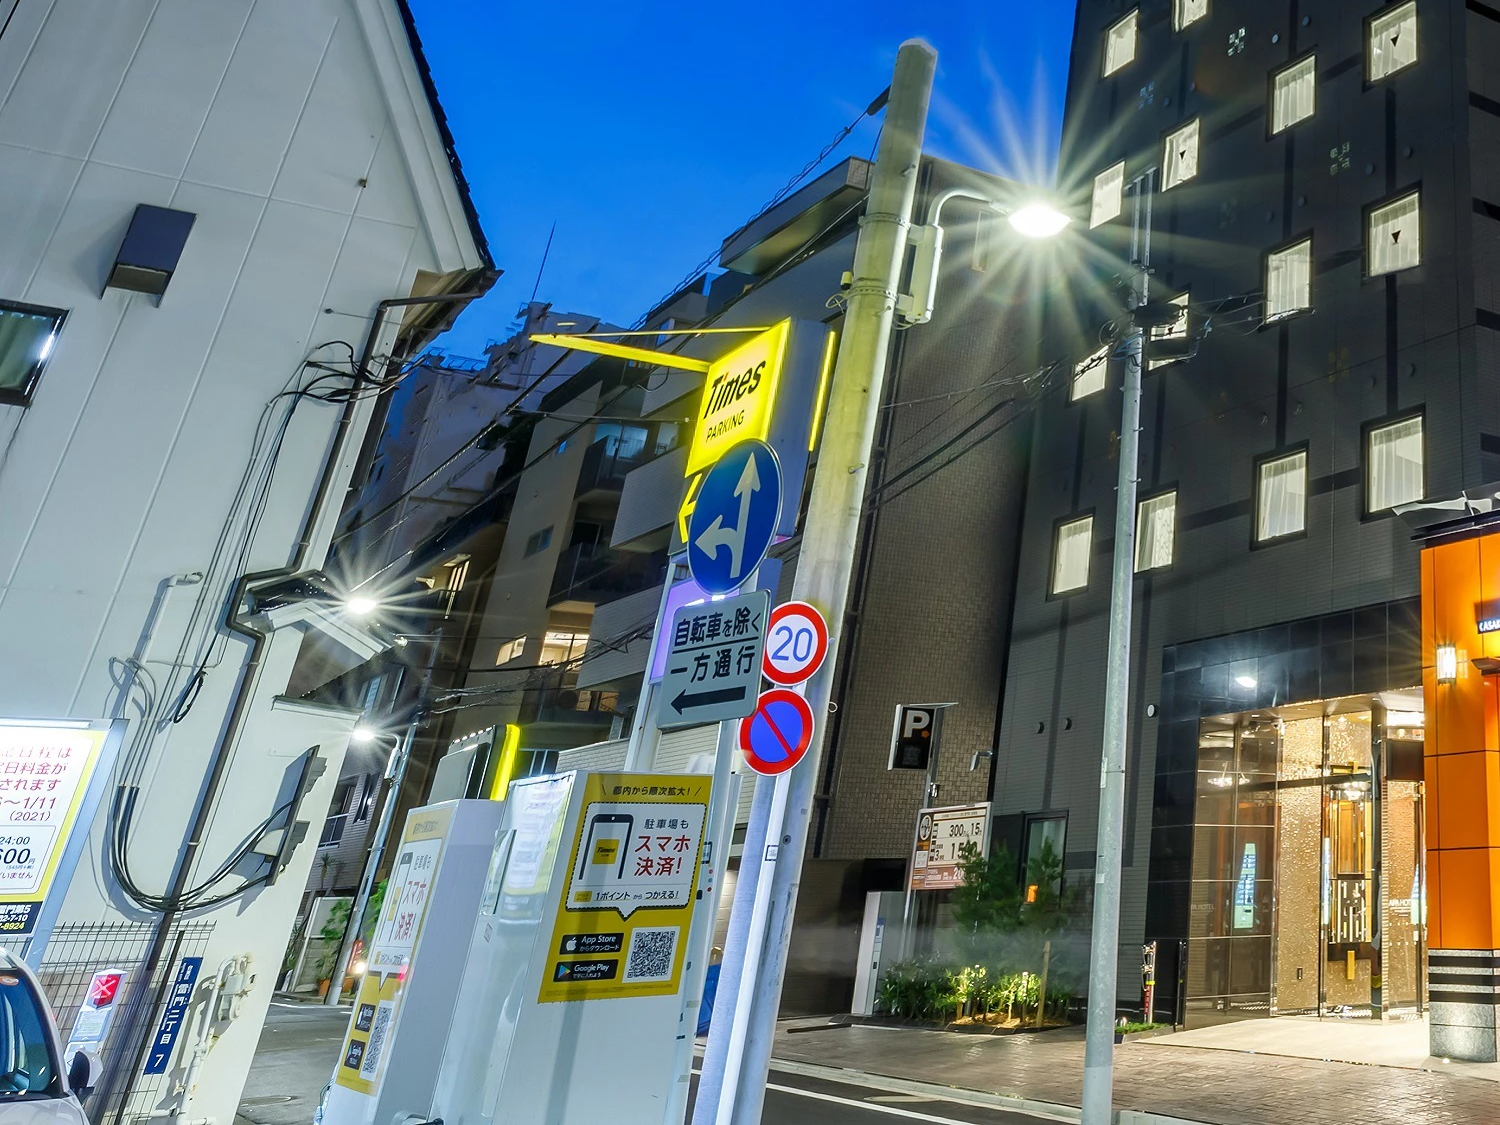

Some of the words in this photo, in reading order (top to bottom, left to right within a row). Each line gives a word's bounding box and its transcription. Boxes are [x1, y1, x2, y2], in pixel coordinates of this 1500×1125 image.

[702, 360, 767, 420] Times
[705, 409, 746, 443] PARKING
[674, 606, 761, 647] 自転車を除く
[771, 625, 813, 662] 20
[670, 645, 755, 684] 一方通行
[903, 709, 930, 738] P
[612, 786, 691, 796] 都内から順次拡大!
[0, 796, 57, 810] 〜1/11
[9, 810, 52, 822] (2021)
[644, 819, 689, 830] 駐車場も
[949, 824, 964, 837] 300
[971, 823, 981, 835] 15
[634, 835, 691, 853] スマホ
[634, 857, 682, 877] 決済!
[595, 891, 631, 901] 1ポイント
[645, 891, 680, 900] つかえる!
[581, 936, 597, 944] App
[597, 935, 617, 943] Store
[574, 965, 596, 973] Google
[596, 963, 610, 972] Play
[160, 983, 190, 1045] 雷門二丁目
[153, 1054, 165, 1068] 7
